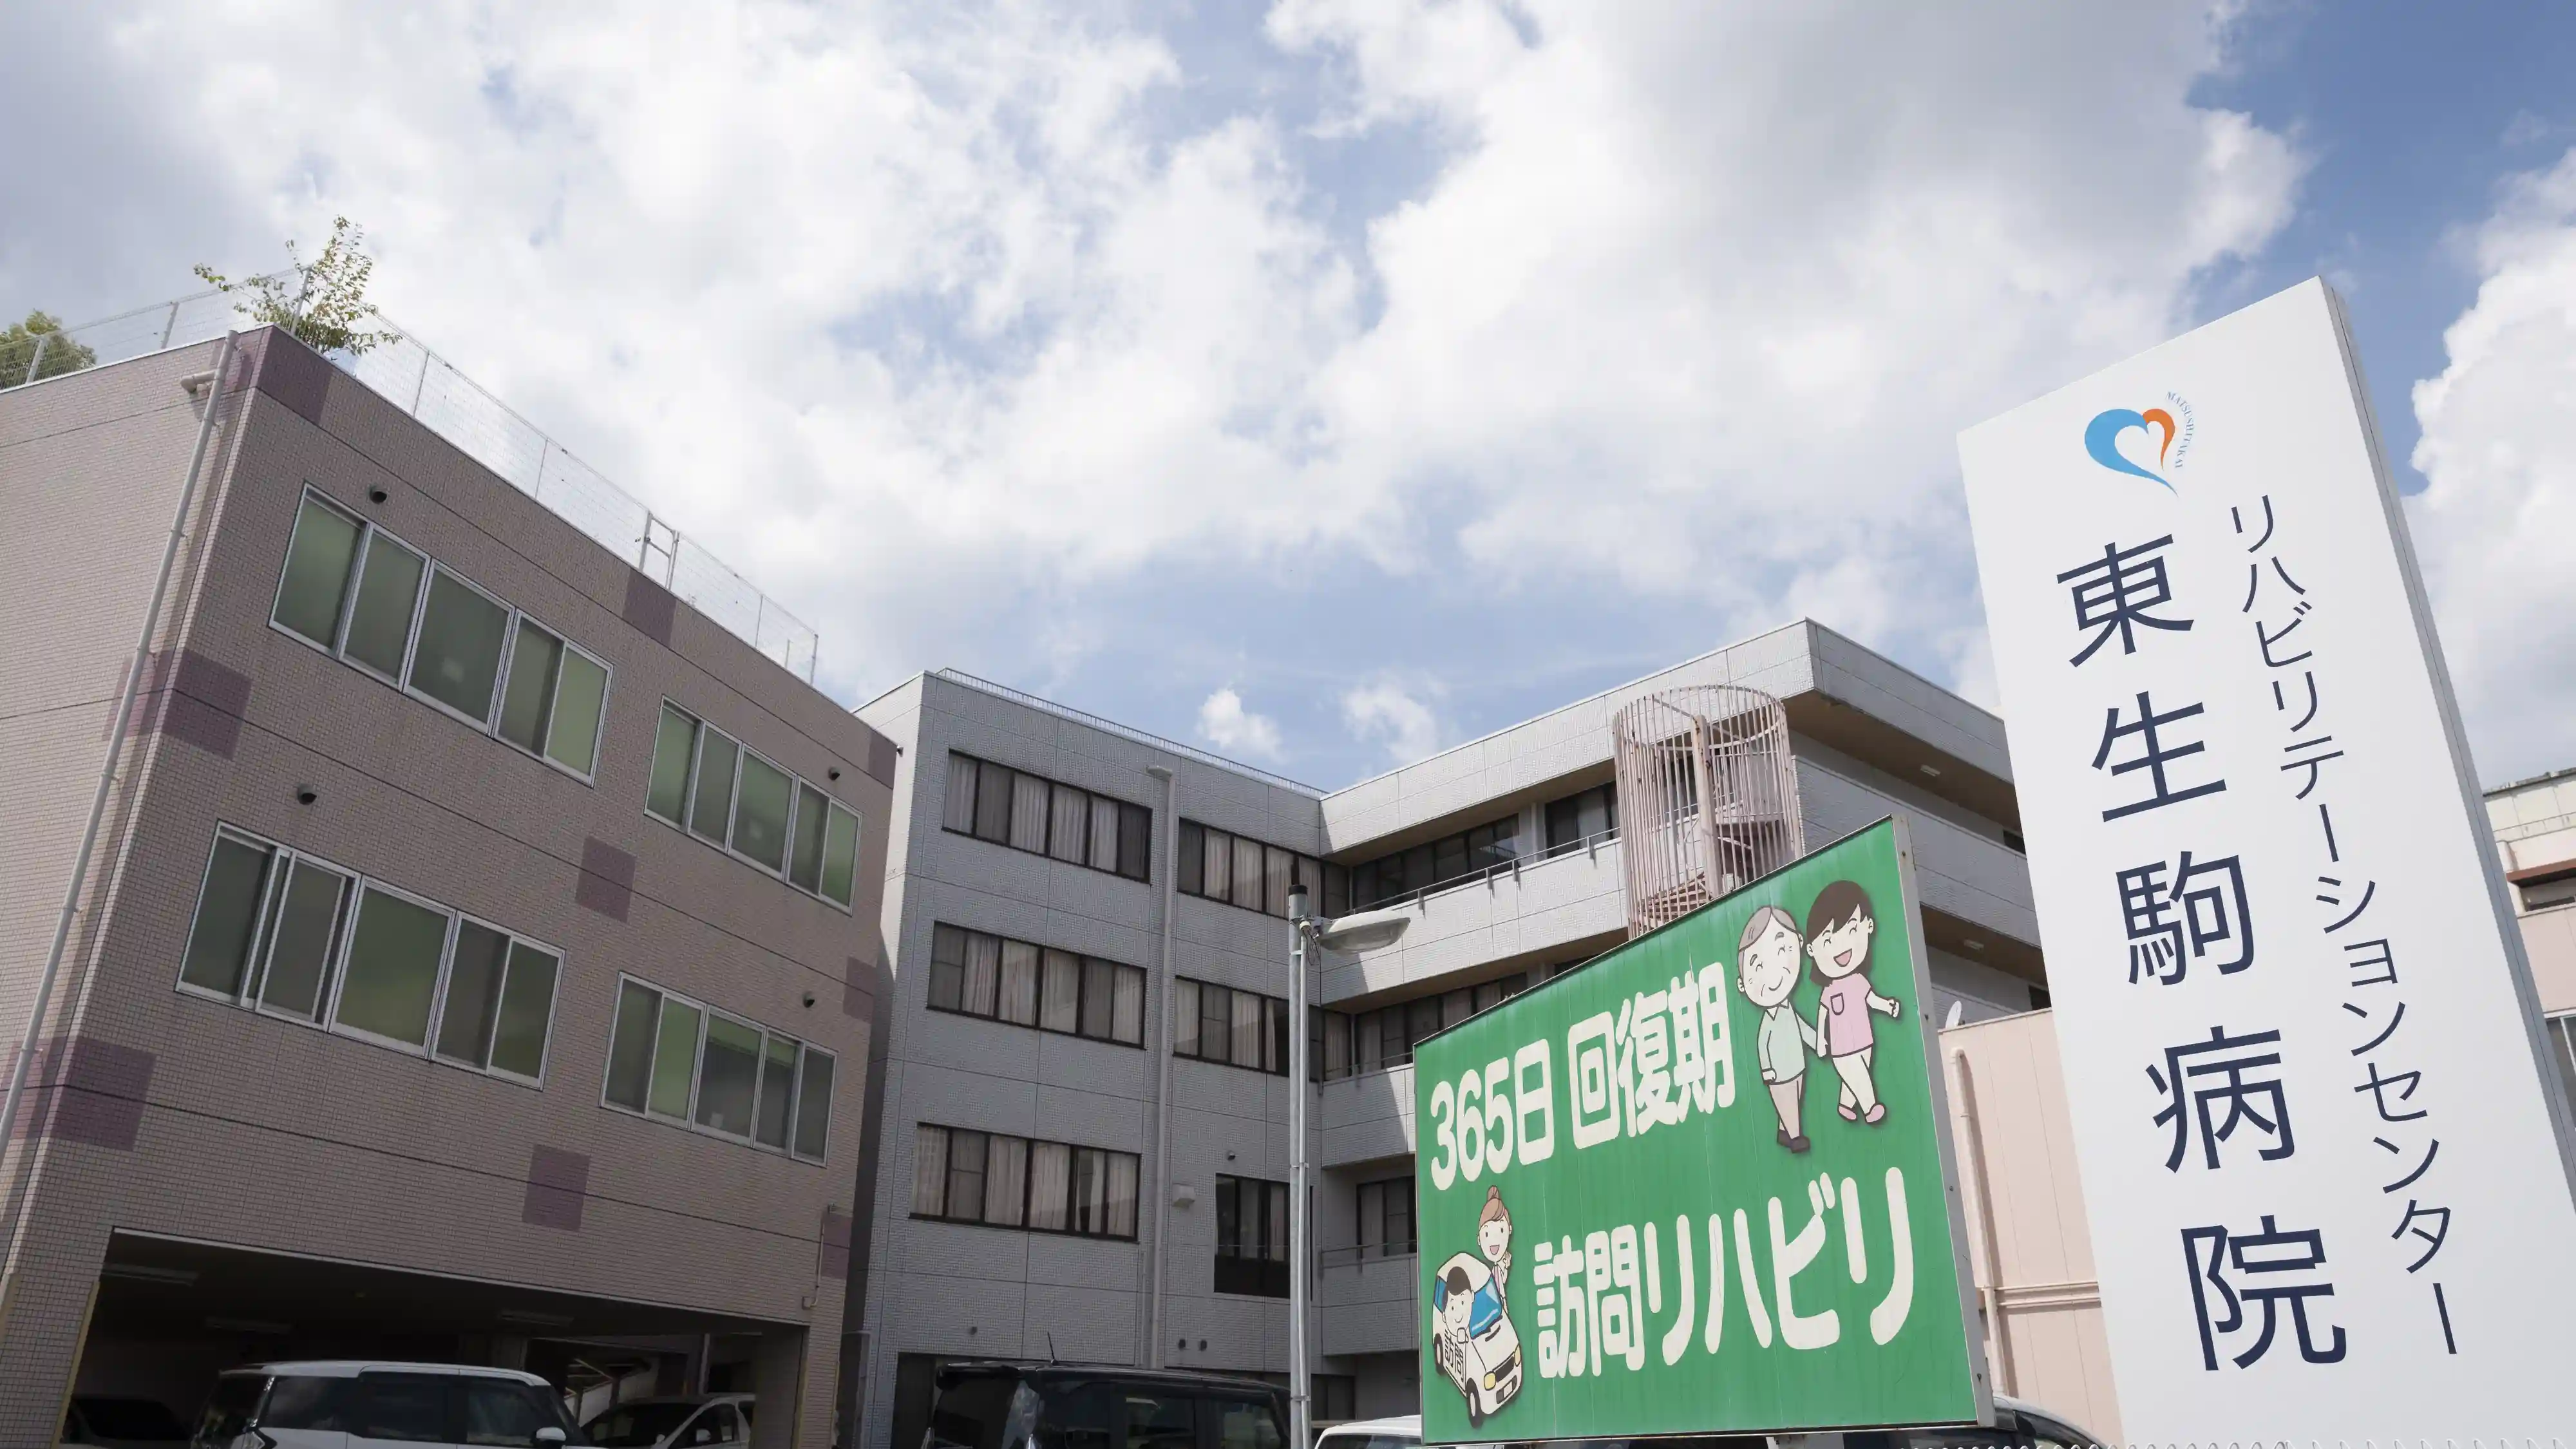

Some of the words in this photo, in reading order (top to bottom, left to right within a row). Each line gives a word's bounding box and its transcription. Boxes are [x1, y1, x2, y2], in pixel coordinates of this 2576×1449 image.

[1430, 1038, 1555, 1191] 365日
[1567, 961, 1736, 1150] 回復期
[2056, 533, 2347, 1371] 東生駒病院
[2231, 495, 2458, 1354] リハビリテーションセンター
[1533, 1166, 1914, 1379] 訪問リハビリ
